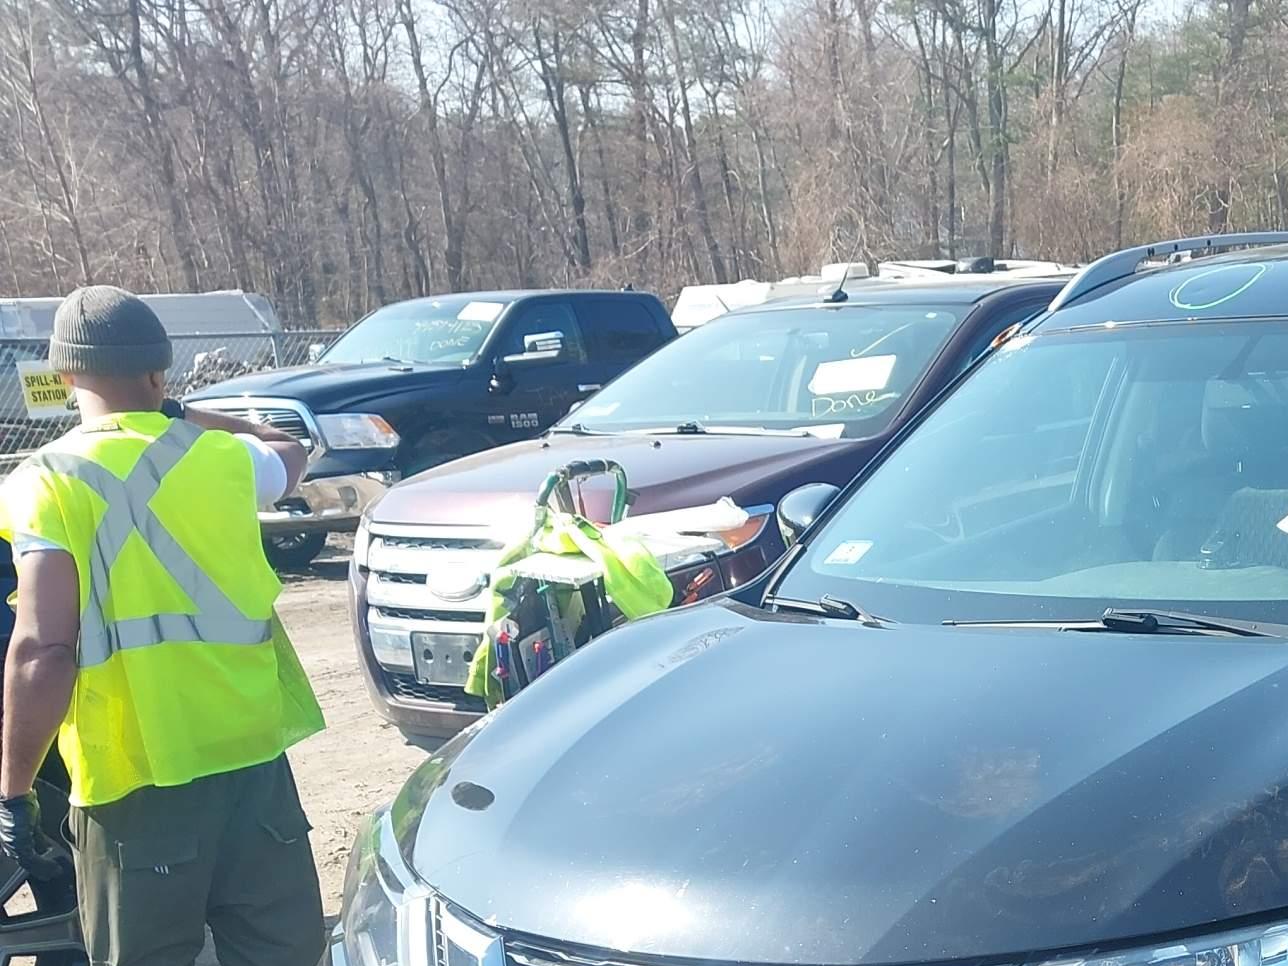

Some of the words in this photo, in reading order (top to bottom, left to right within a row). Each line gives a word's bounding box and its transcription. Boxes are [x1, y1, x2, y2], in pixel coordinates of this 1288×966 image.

[24, 374, 62, 388] SPILL-KI
[31, 389, 67, 403] STATION
[811, 391, 900, 417] Done
[511, 420, 539, 429] 1500
